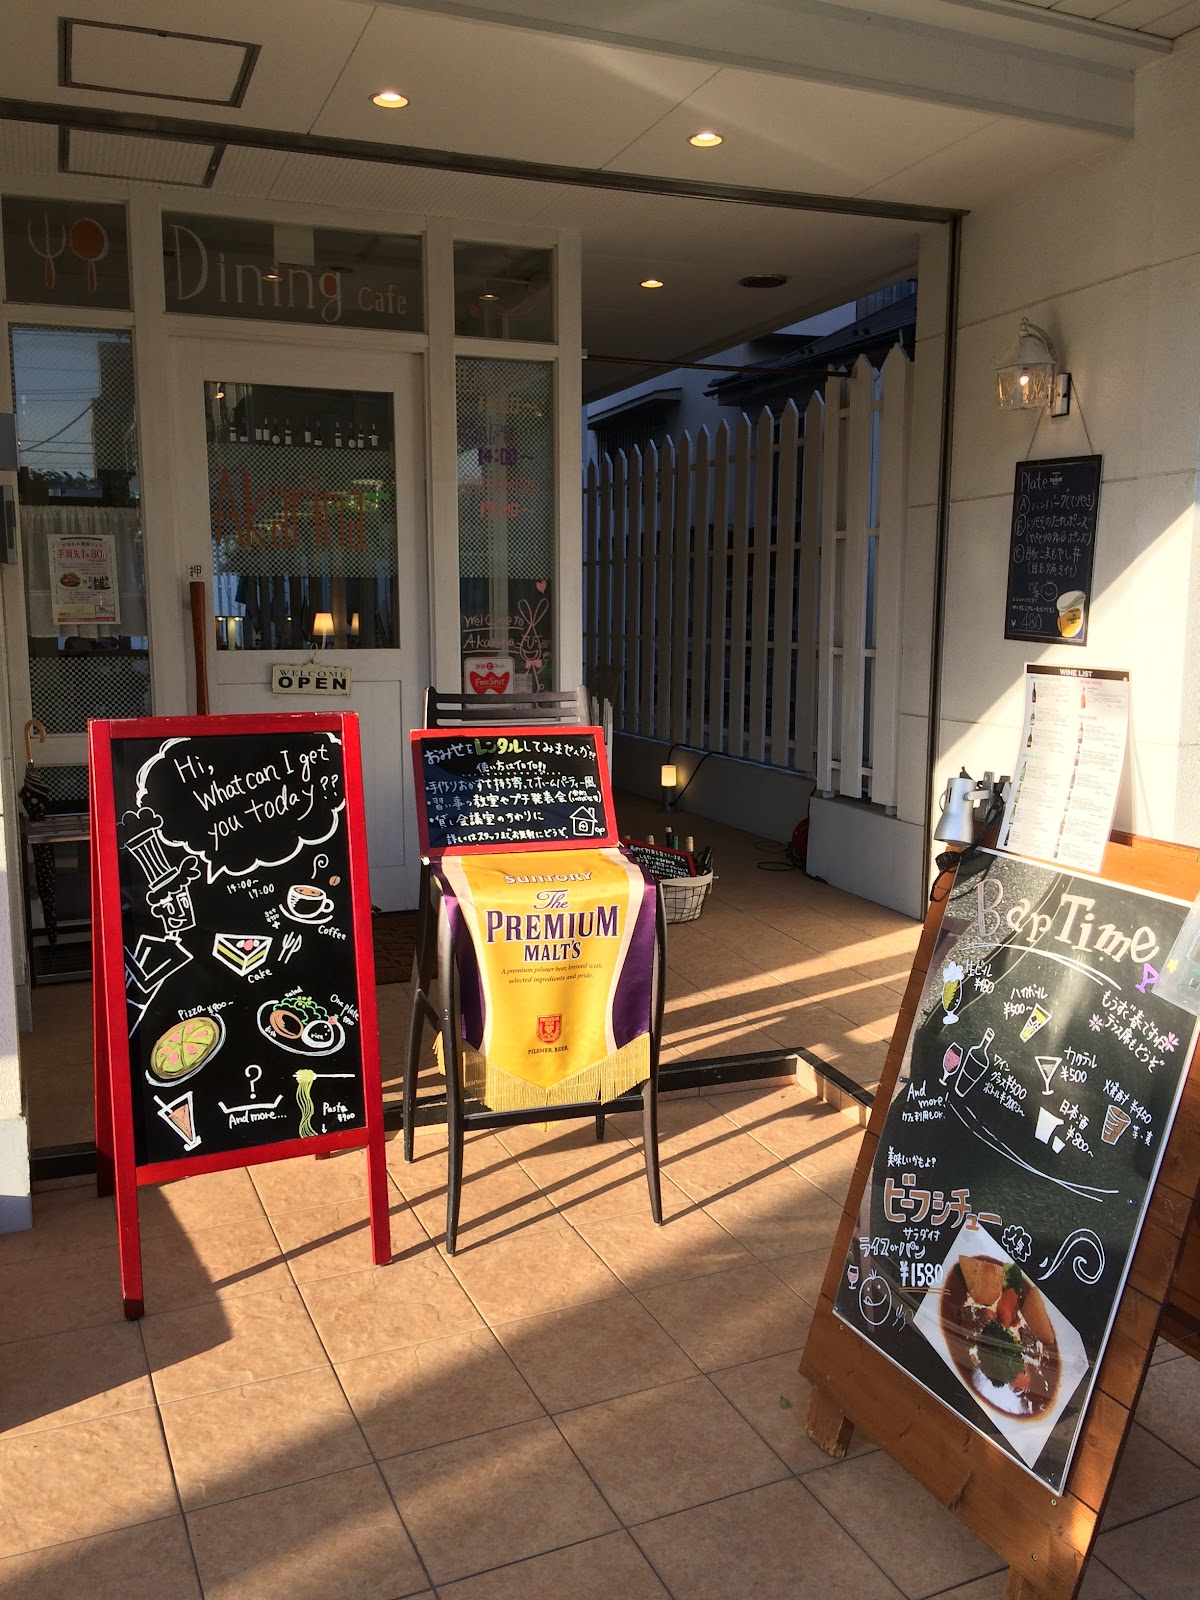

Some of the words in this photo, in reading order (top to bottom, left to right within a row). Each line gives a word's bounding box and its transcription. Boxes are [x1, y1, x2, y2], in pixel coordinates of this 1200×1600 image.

[170, 224, 343, 323] Dining
[1021, 471, 1048, 493] Plate
[214, 467, 367, 550] Akarina
[188, 565, 202, 577] 押
[278, 676, 347, 690] OPEN
[280, 669, 347, 678] WELCOME
[1060, 669, 1078, 677] WINE
[1078, 670, 1093, 678] LIST
[174, 755, 215, 783] Hi,
[193, 774, 246, 811] What
[245, 765, 281, 790] can
[280, 750, 295, 775] I
[299, 743, 330, 782] get
[208, 815, 244, 851] you
[504, 871, 593, 884] SUNTORY
[533, 888, 570, 910] The
[317, 924, 347, 940] Coffee
[485, 905, 618, 943] PREMIUM
[1054, 893, 1160, 963] Time
[523, 940, 581, 962] MALT'S
[507, 966, 533, 975] premium
[534, 965, 554, 974] pilsner
[509, 976, 532, 984] selected
[533, 974, 565, 984] ingredients
[178, 1005, 206, 1020] Pizza
[528, 1047, 553, 1055] PILSNER
[554, 1045, 569, 1053] BEER
[994, 1053, 1011, 1071] ワイン
[1060, 1065, 1088, 1083] ¥500
[906, 1080, 927, 1102] And
[229, 1099, 249, 1129] And
[322, 1101, 348, 1116] Pasta
[1059, 1099, 1090, 1130] 日本酒
[1129, 1099, 1153, 1124] ¥450
[883, 1173, 1003, 1232] ビーフシチュー
[899, 1260, 944, 1288] ¥1580
